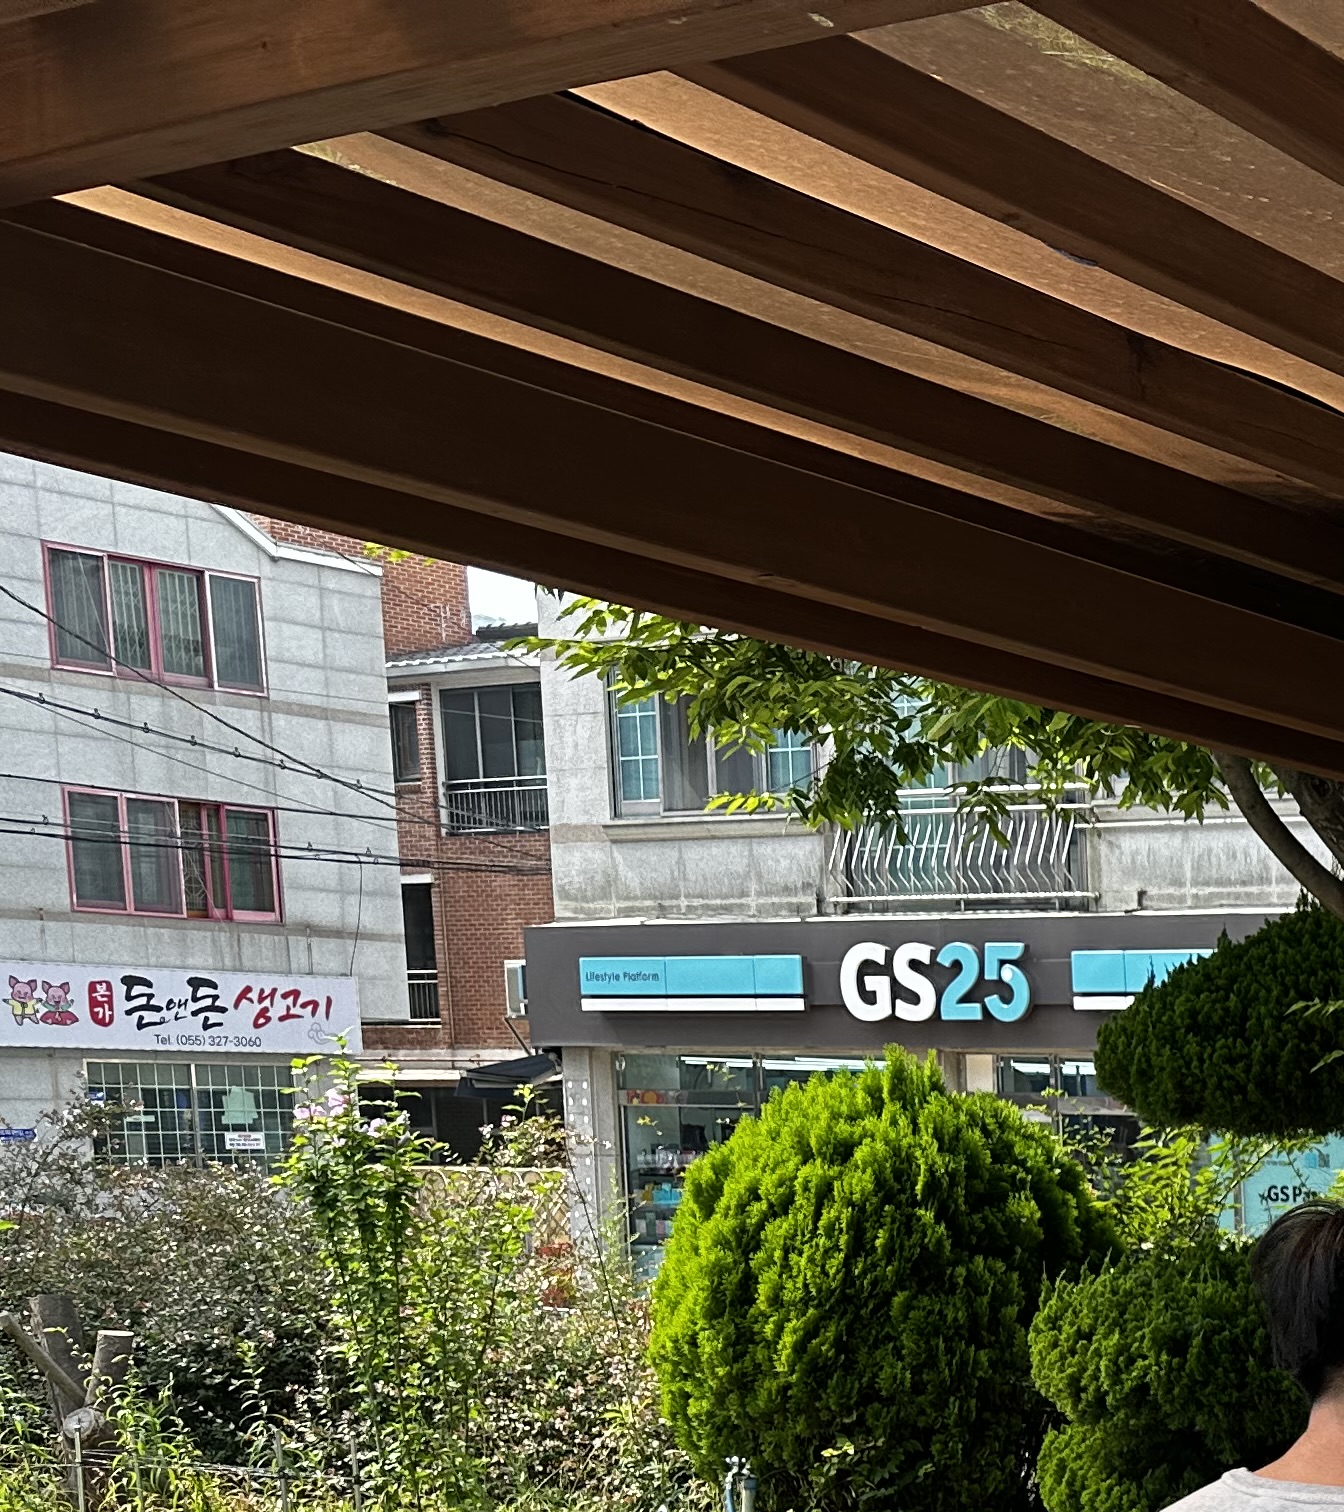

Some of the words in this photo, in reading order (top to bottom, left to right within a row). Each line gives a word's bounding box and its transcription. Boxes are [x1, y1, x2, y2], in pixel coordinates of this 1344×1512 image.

[585, 970, 620, 984] Lifestyle
[623, 970, 660, 983] Platform
[839, 940, 1031, 1023] GS25
[91, 982, 113, 1026] 본가
[233, 984, 333, 1030] 생고기
[176, 1034, 206, 1047] (055)
[208, 1035, 262, 1048] 327-3060
